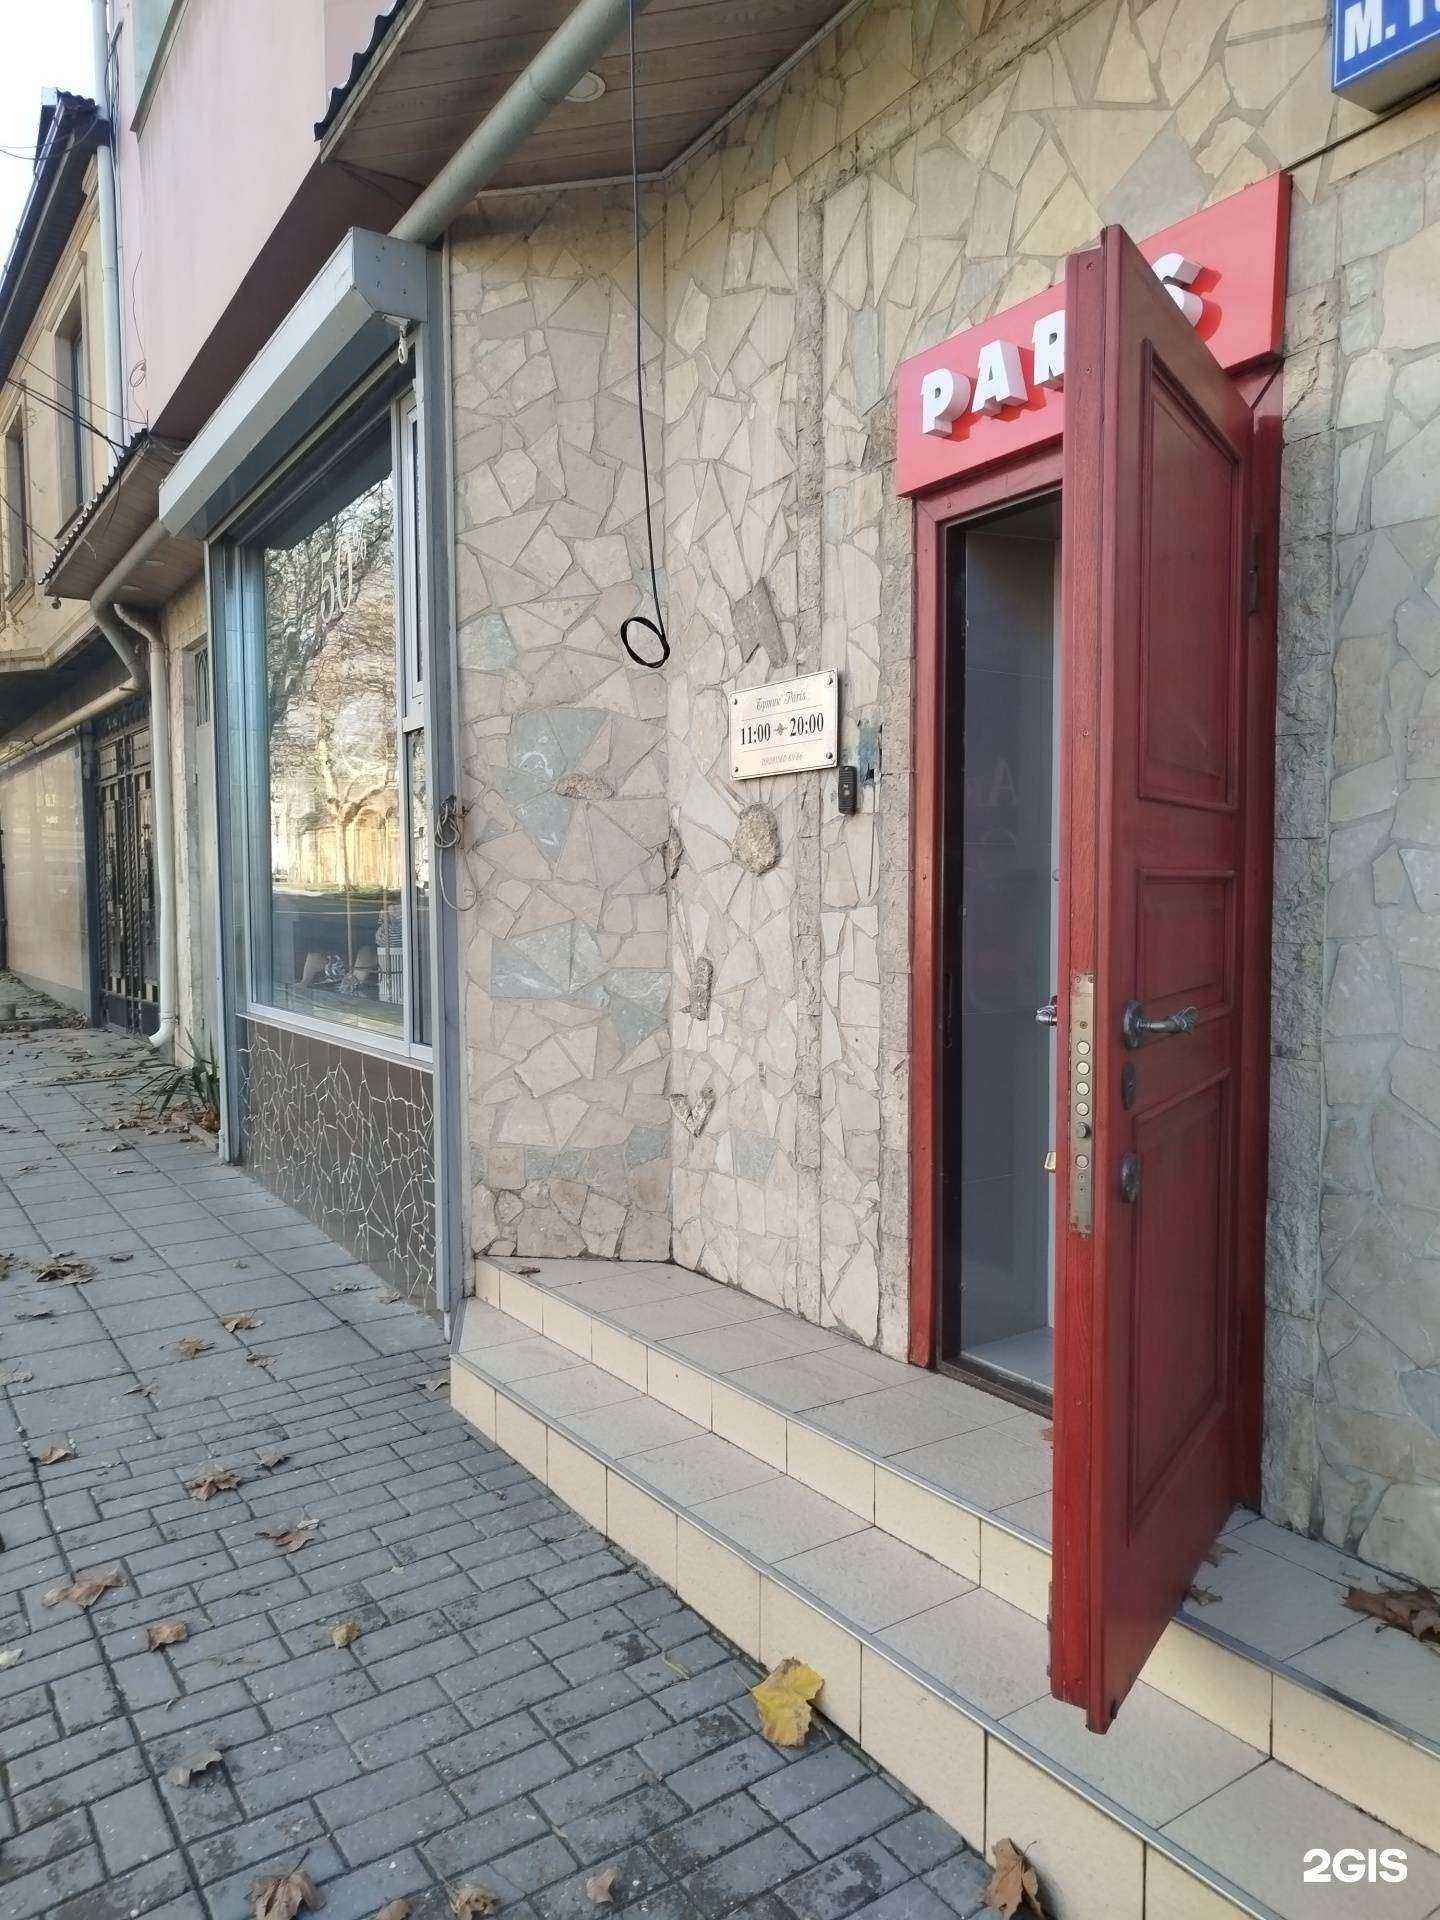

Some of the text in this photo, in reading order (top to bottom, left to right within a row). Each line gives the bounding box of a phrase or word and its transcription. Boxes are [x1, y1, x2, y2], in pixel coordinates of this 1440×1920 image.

[920, 252, 1206, 436] PARS
[740, 712, 824, 745] 11:00 20:00
